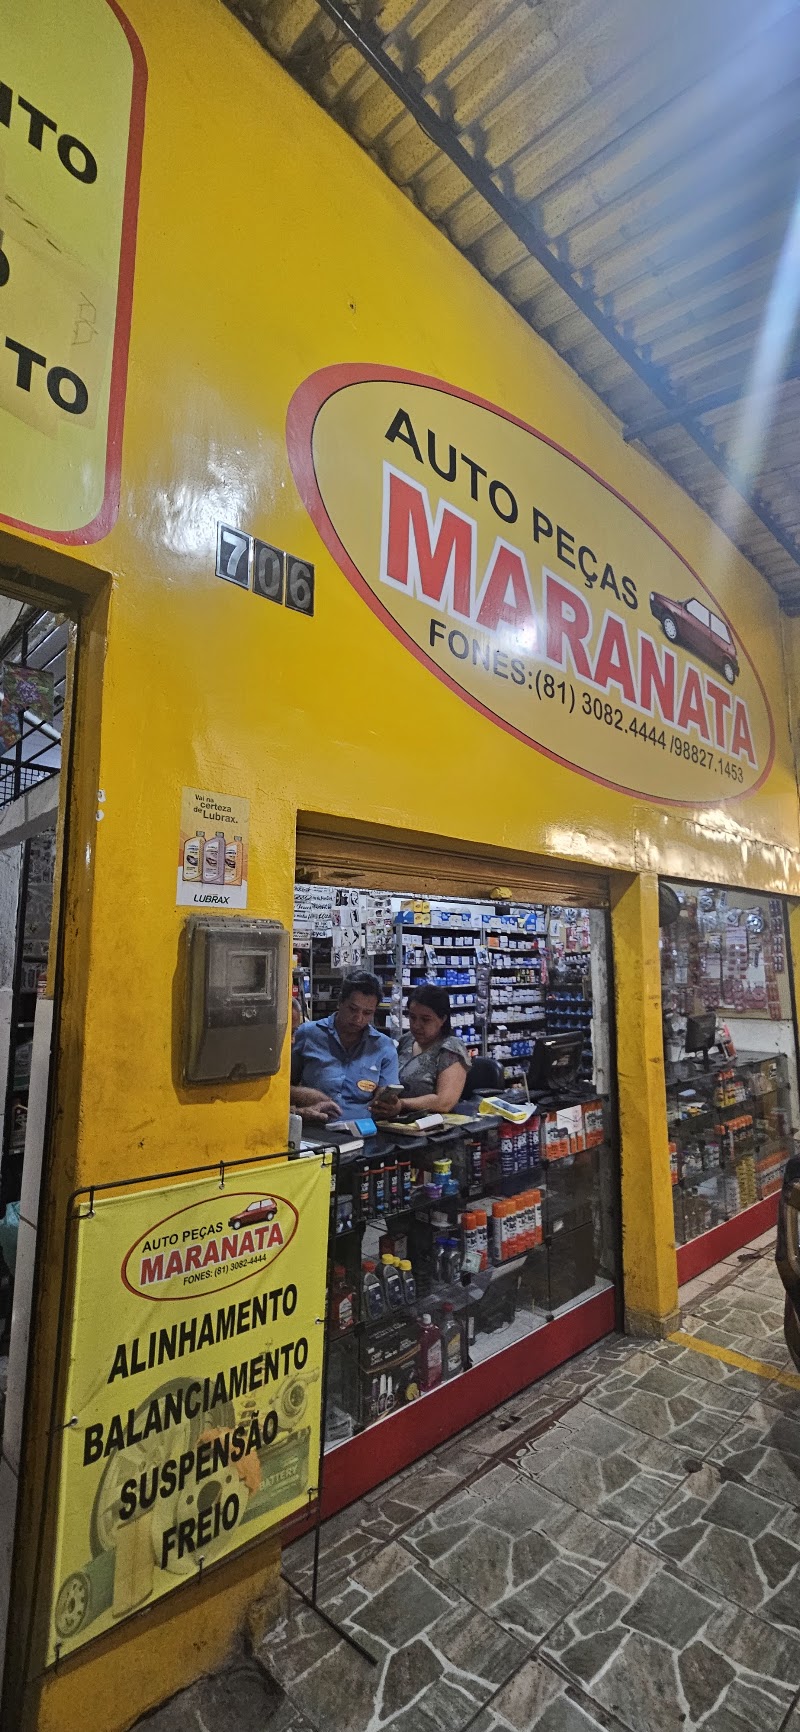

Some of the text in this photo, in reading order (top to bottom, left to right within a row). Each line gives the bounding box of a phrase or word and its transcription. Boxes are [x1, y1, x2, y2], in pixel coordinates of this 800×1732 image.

[384, 408, 638, 610] AUTO PEÇAS
[222, 531, 311, 609] 706
[381, 462, 757, 768] MARANATA
[581, 693, 666, 750] 3082.4444
[193, 805, 238, 824] de Lubrax.
[194, 793, 204, 801] Vai
[200, 801, 232, 813] certeza
[193, 894, 230, 904] LUBRAX
[139, 1222, 284, 1286] MARANATA
[142, 1222, 223, 1253] AUTO PEÇAS
[183, 1253, 267, 1286] FONES: (81) 3082-4444
[107, 1283, 297, 1383] ALINHAMENTO
[83, 1337, 308, 1467] BALANCIAMENTO
[119, 1410, 278, 1521] SUSPENSÃO
[160, 1495, 240, 1570] FREIO
